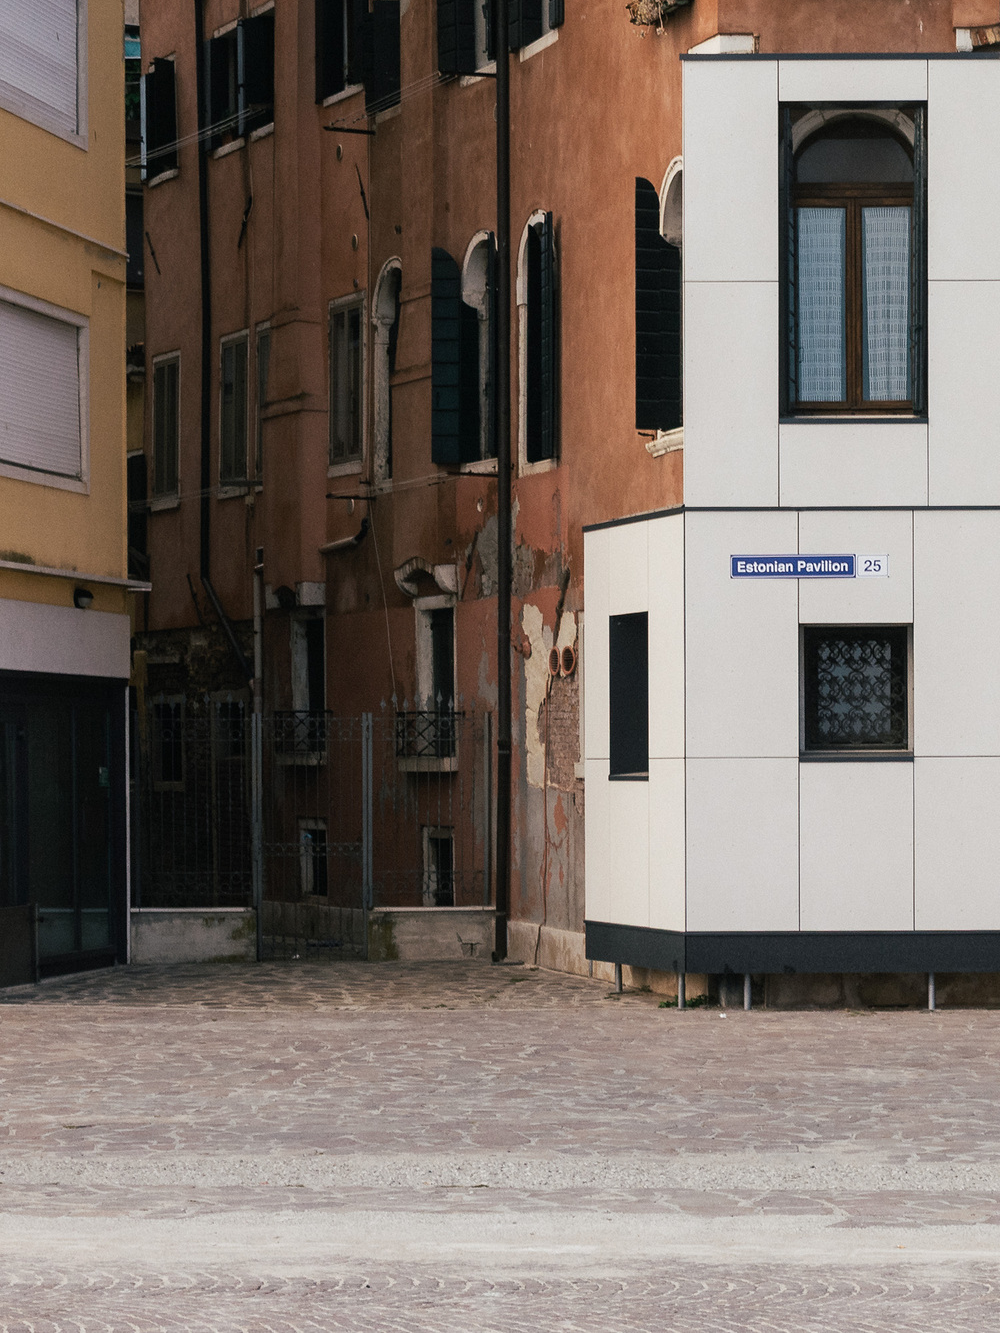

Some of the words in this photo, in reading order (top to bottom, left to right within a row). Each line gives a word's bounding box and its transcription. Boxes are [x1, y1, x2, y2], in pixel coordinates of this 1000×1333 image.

[737, 560, 793, 573] Estonian
[797, 560, 849, 572] Pavilion
[864, 559, 881, 572] 25
